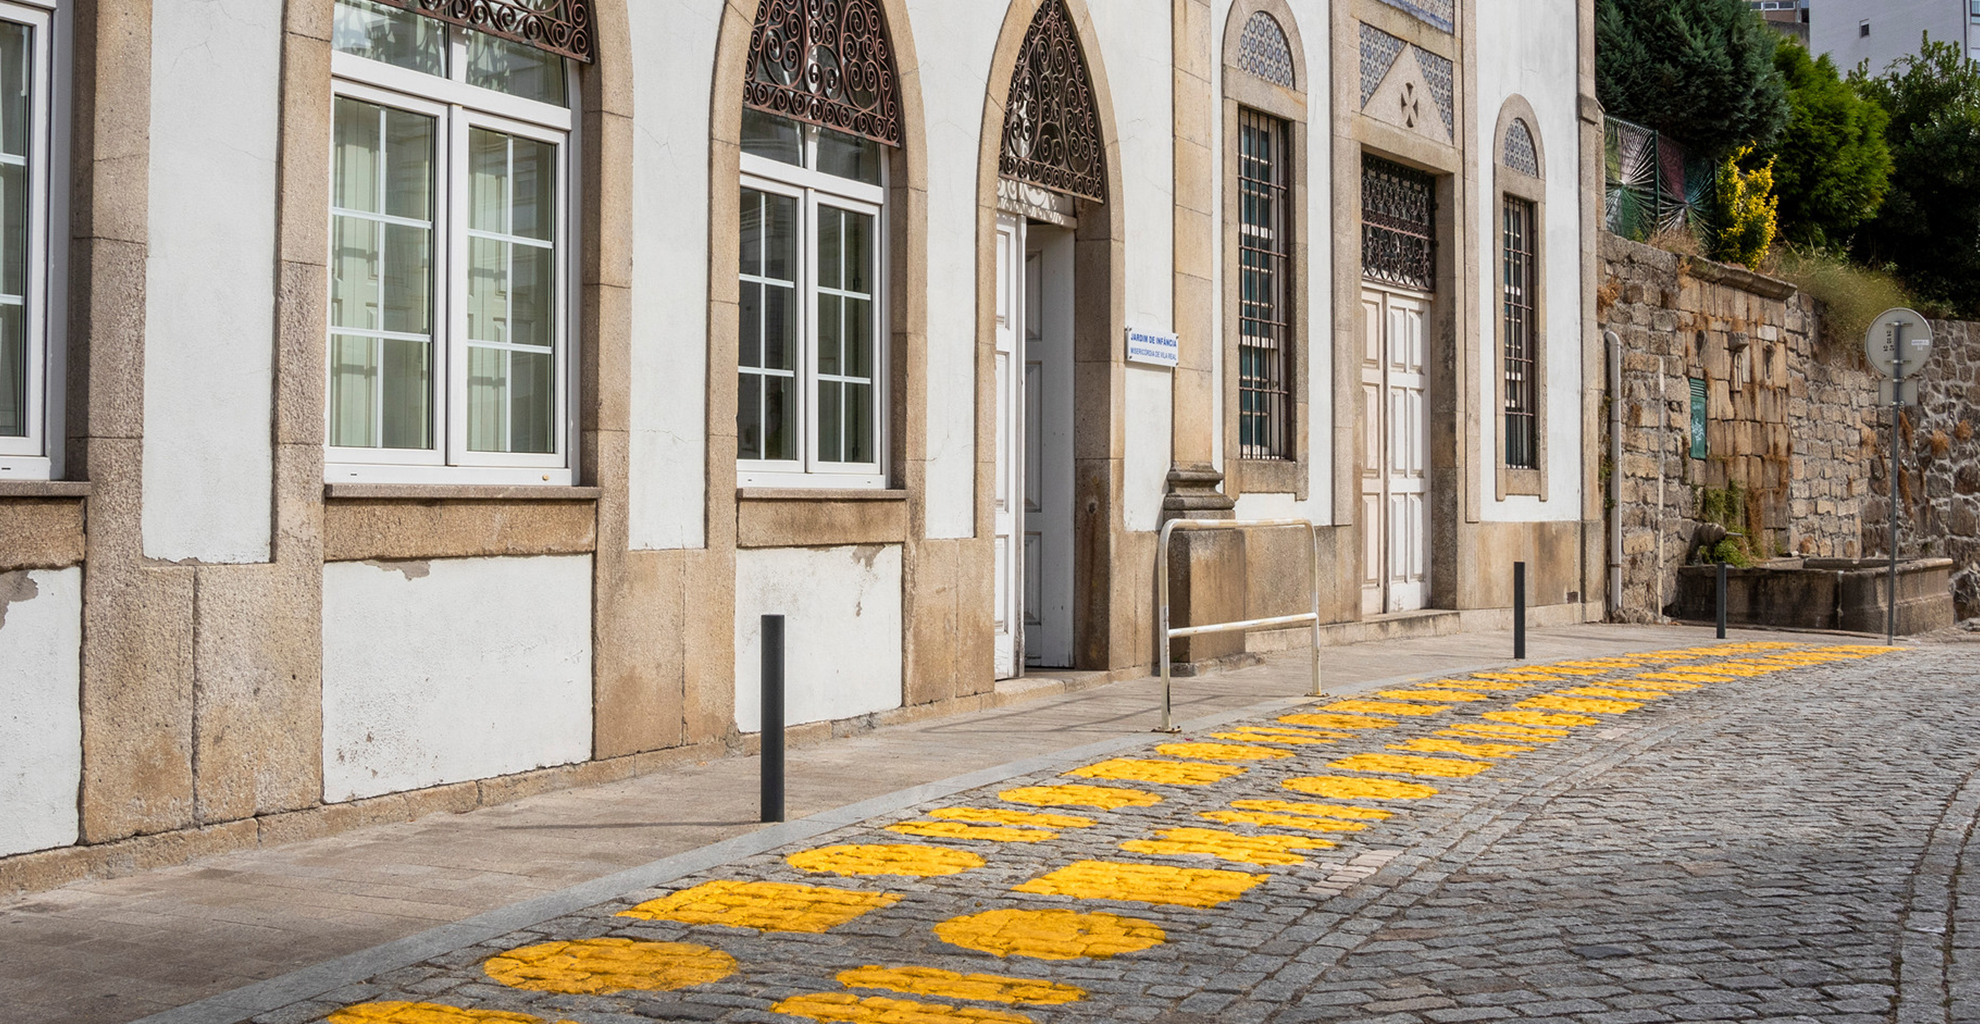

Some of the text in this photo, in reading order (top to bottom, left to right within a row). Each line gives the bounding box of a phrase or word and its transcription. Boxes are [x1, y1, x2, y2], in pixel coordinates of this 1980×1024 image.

[1130, 333, 1177, 347] JARDIM DE INFÂNCIA
